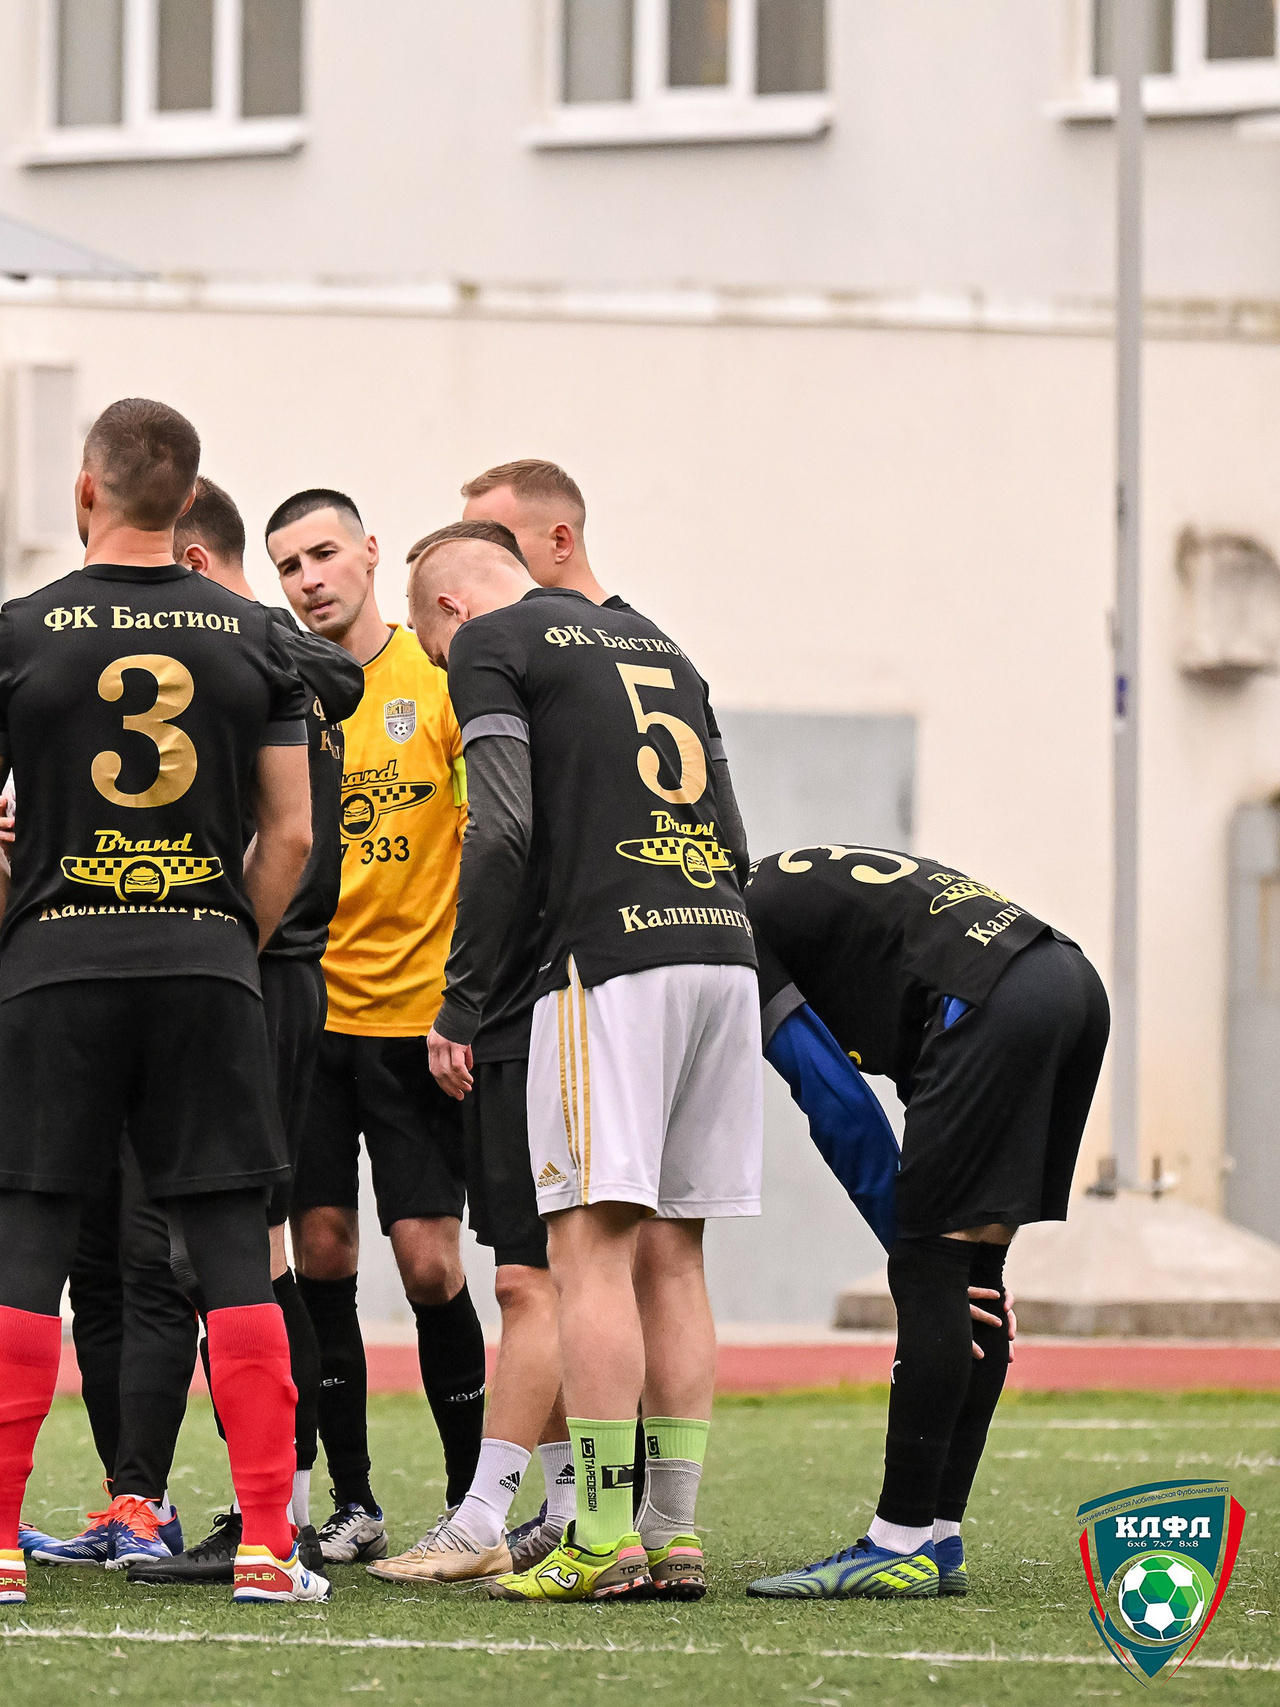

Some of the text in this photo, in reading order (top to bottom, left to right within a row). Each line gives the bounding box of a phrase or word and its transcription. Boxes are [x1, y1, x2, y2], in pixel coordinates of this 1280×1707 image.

[43, 605, 241, 634] ФК Бастион
[544, 625, 686, 660] ФК Бастио
[91, 654, 197, 808] 3
[616, 662, 706, 805] 5
[342, 759, 399, 787] and
[94, 830, 193, 853] Brand
[360, 835, 410, 865] 333
[585, 1459, 597, 1512] TAPEDESIGN
[234, 1573, 276, 1582] P-FLEX
